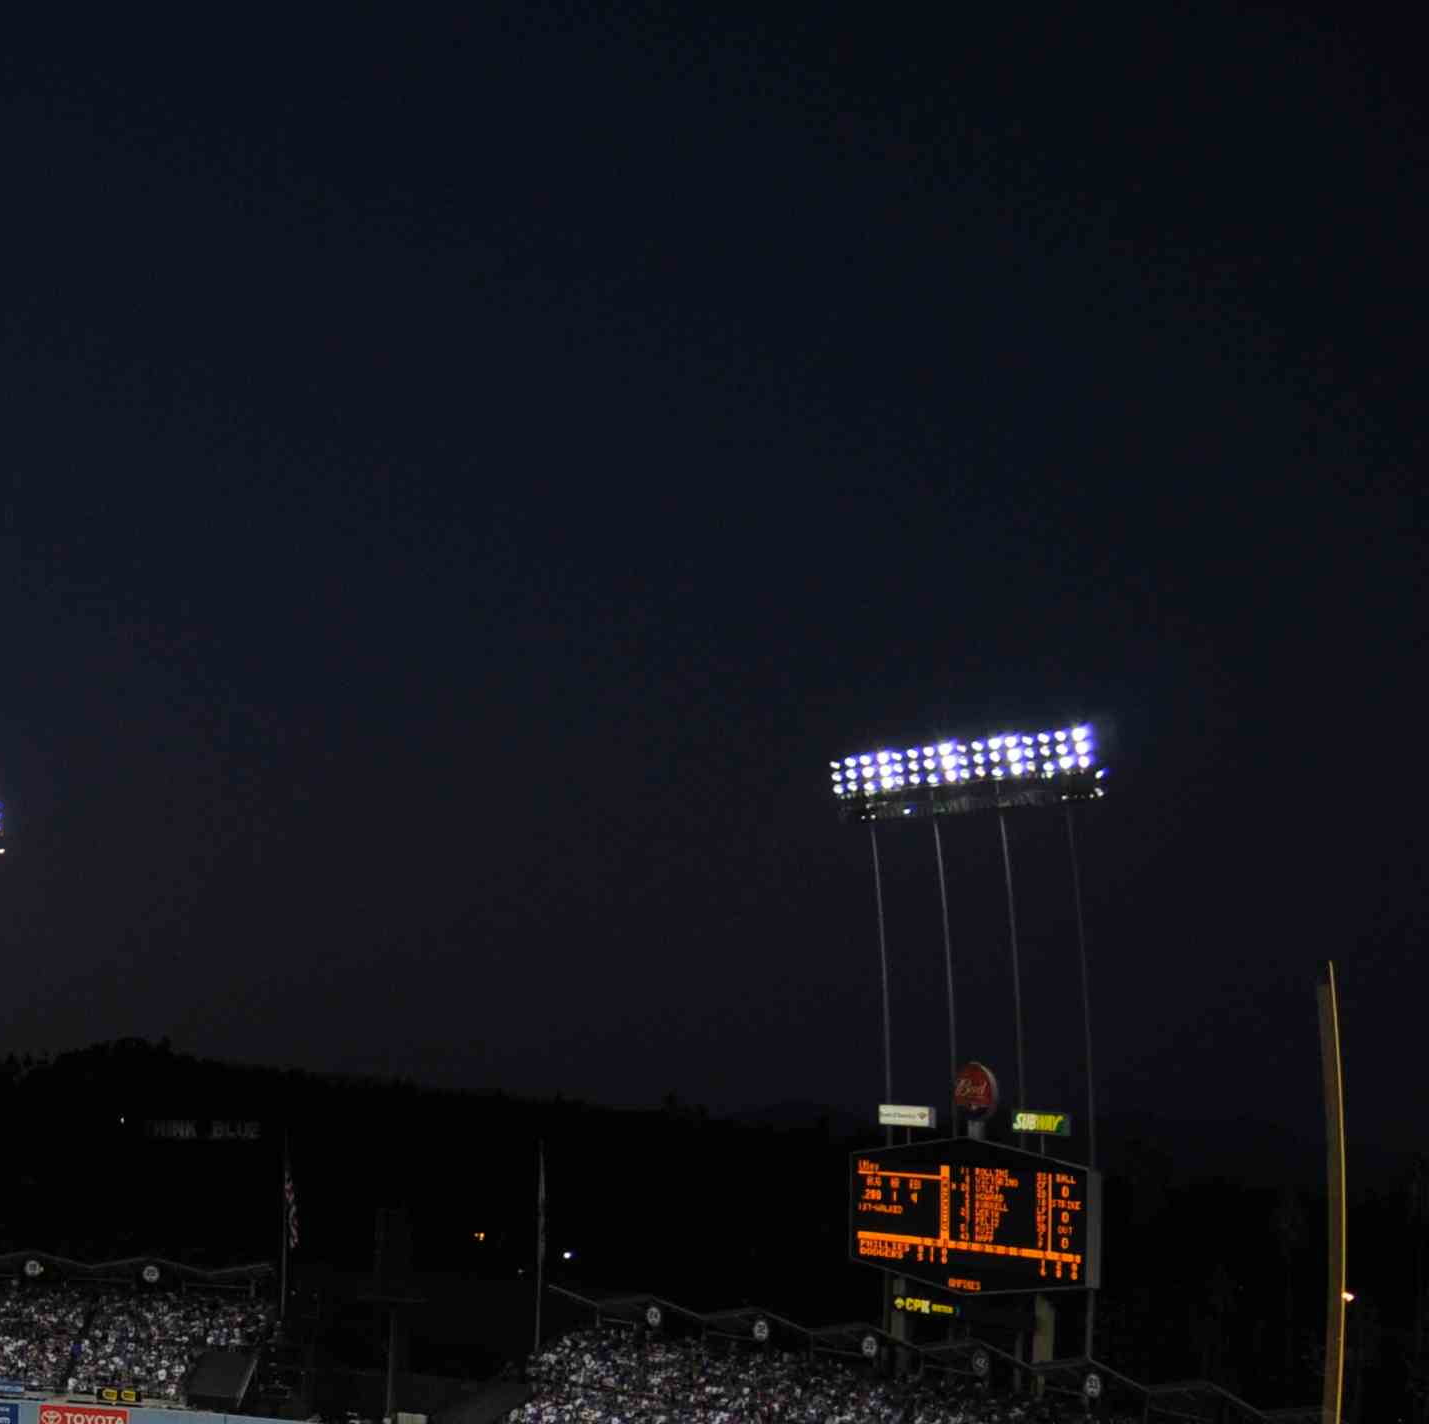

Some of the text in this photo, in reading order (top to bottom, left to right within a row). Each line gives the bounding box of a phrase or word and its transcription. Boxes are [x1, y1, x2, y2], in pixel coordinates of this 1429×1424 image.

[1012, 1112, 1065, 1133] SUBWAY
[1060, 1185, 1070, 1198] 0
[1060, 1211, 1070, 1224] 0
